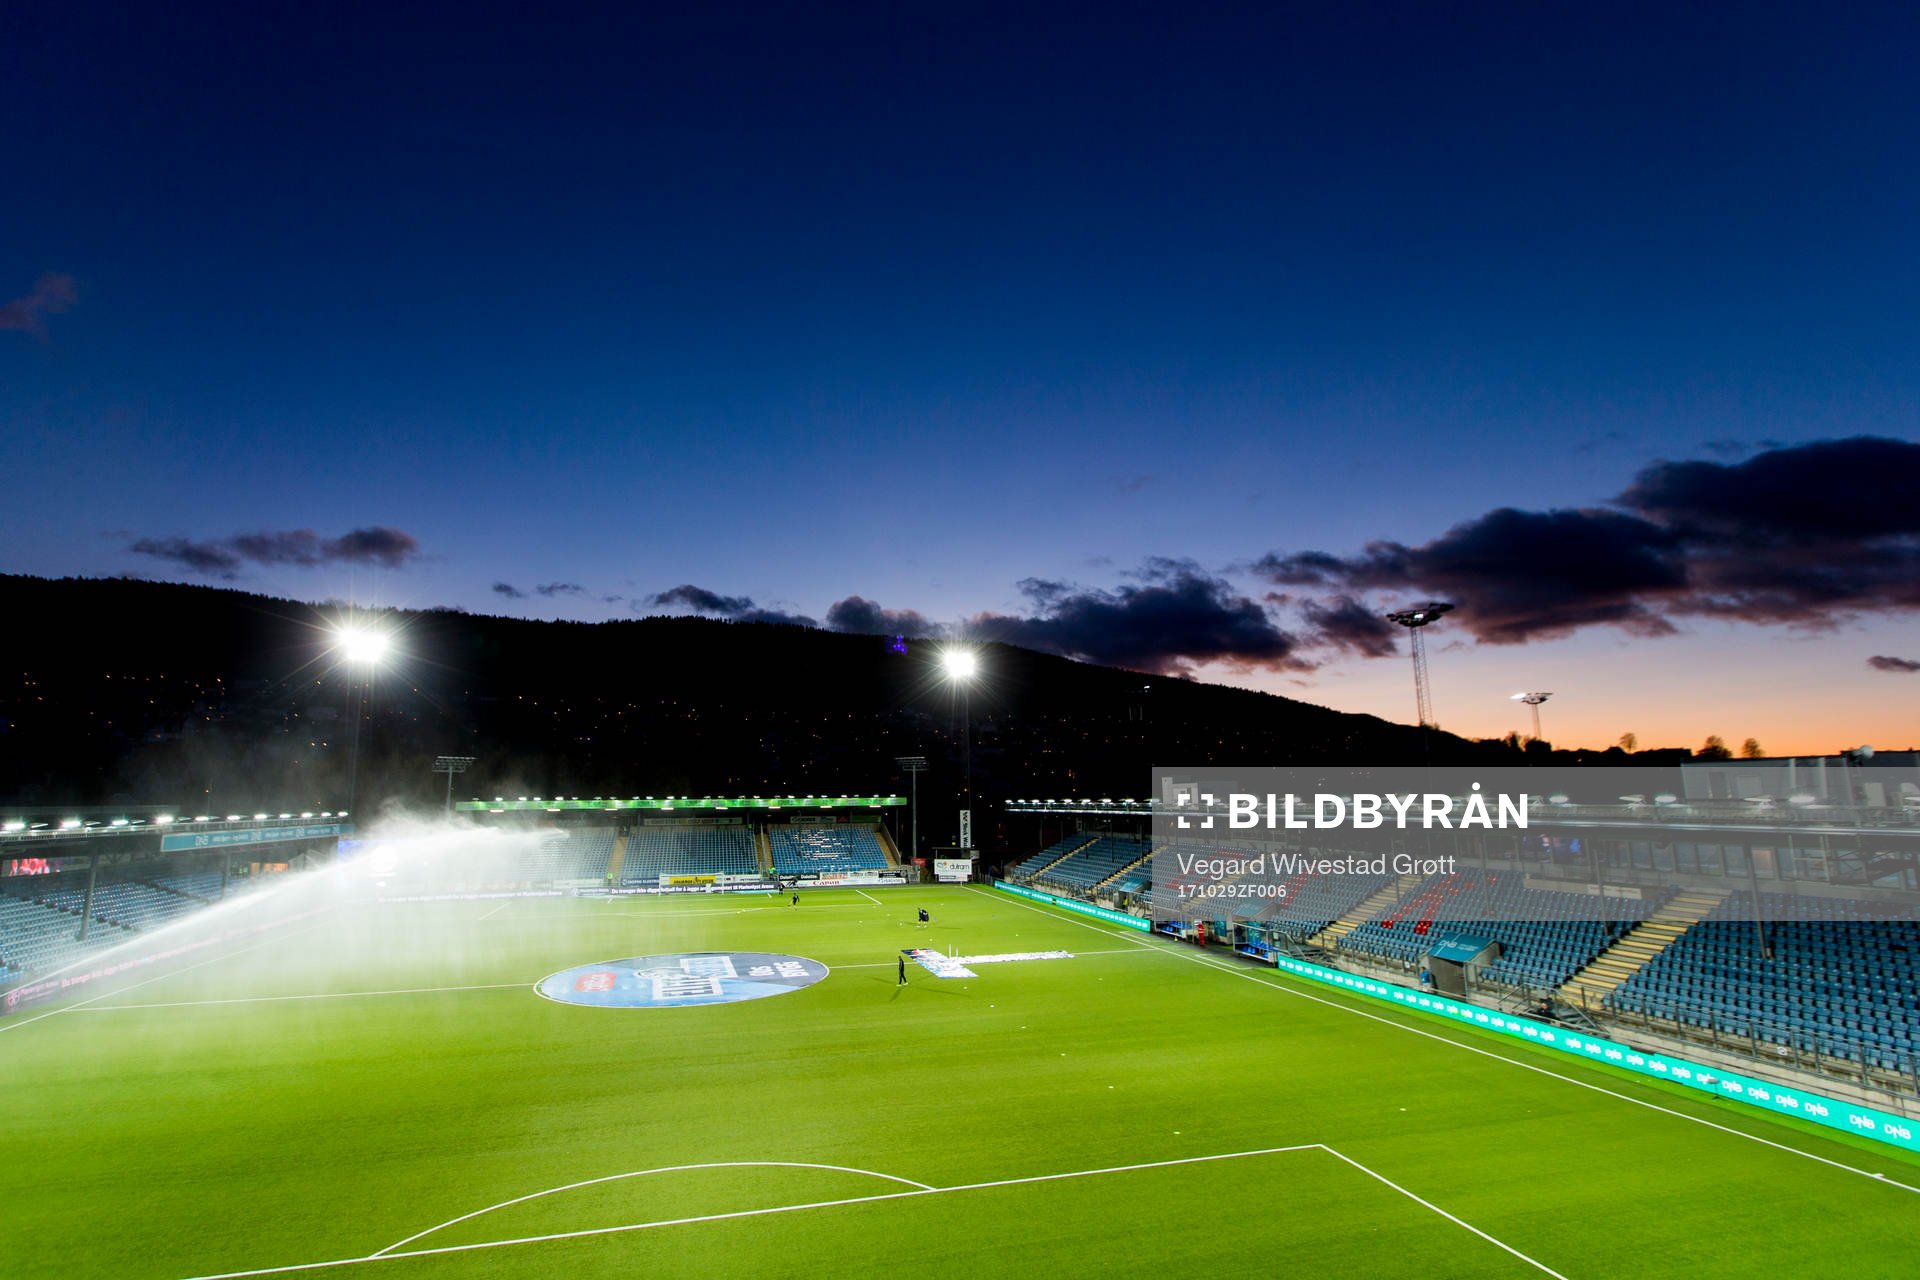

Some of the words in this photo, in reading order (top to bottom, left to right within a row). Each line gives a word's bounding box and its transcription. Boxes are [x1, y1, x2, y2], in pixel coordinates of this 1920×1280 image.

[1606, 1049, 1622, 1060] DNB
[1627, 1055, 1644, 1066] DNB
[1649, 1061, 1668, 1073] DNB
[1671, 1067, 1691, 1079] DNB
[1722, 1080, 1743, 1093] DNB
[1748, 1087, 1770, 1100] DNB
[1775, 1095, 1799, 1108] DNB
[1804, 1102, 1829, 1117] DNB
[1849, 1114, 1875, 1130] DNB
[1884, 1123, 1912, 1140] DNB
